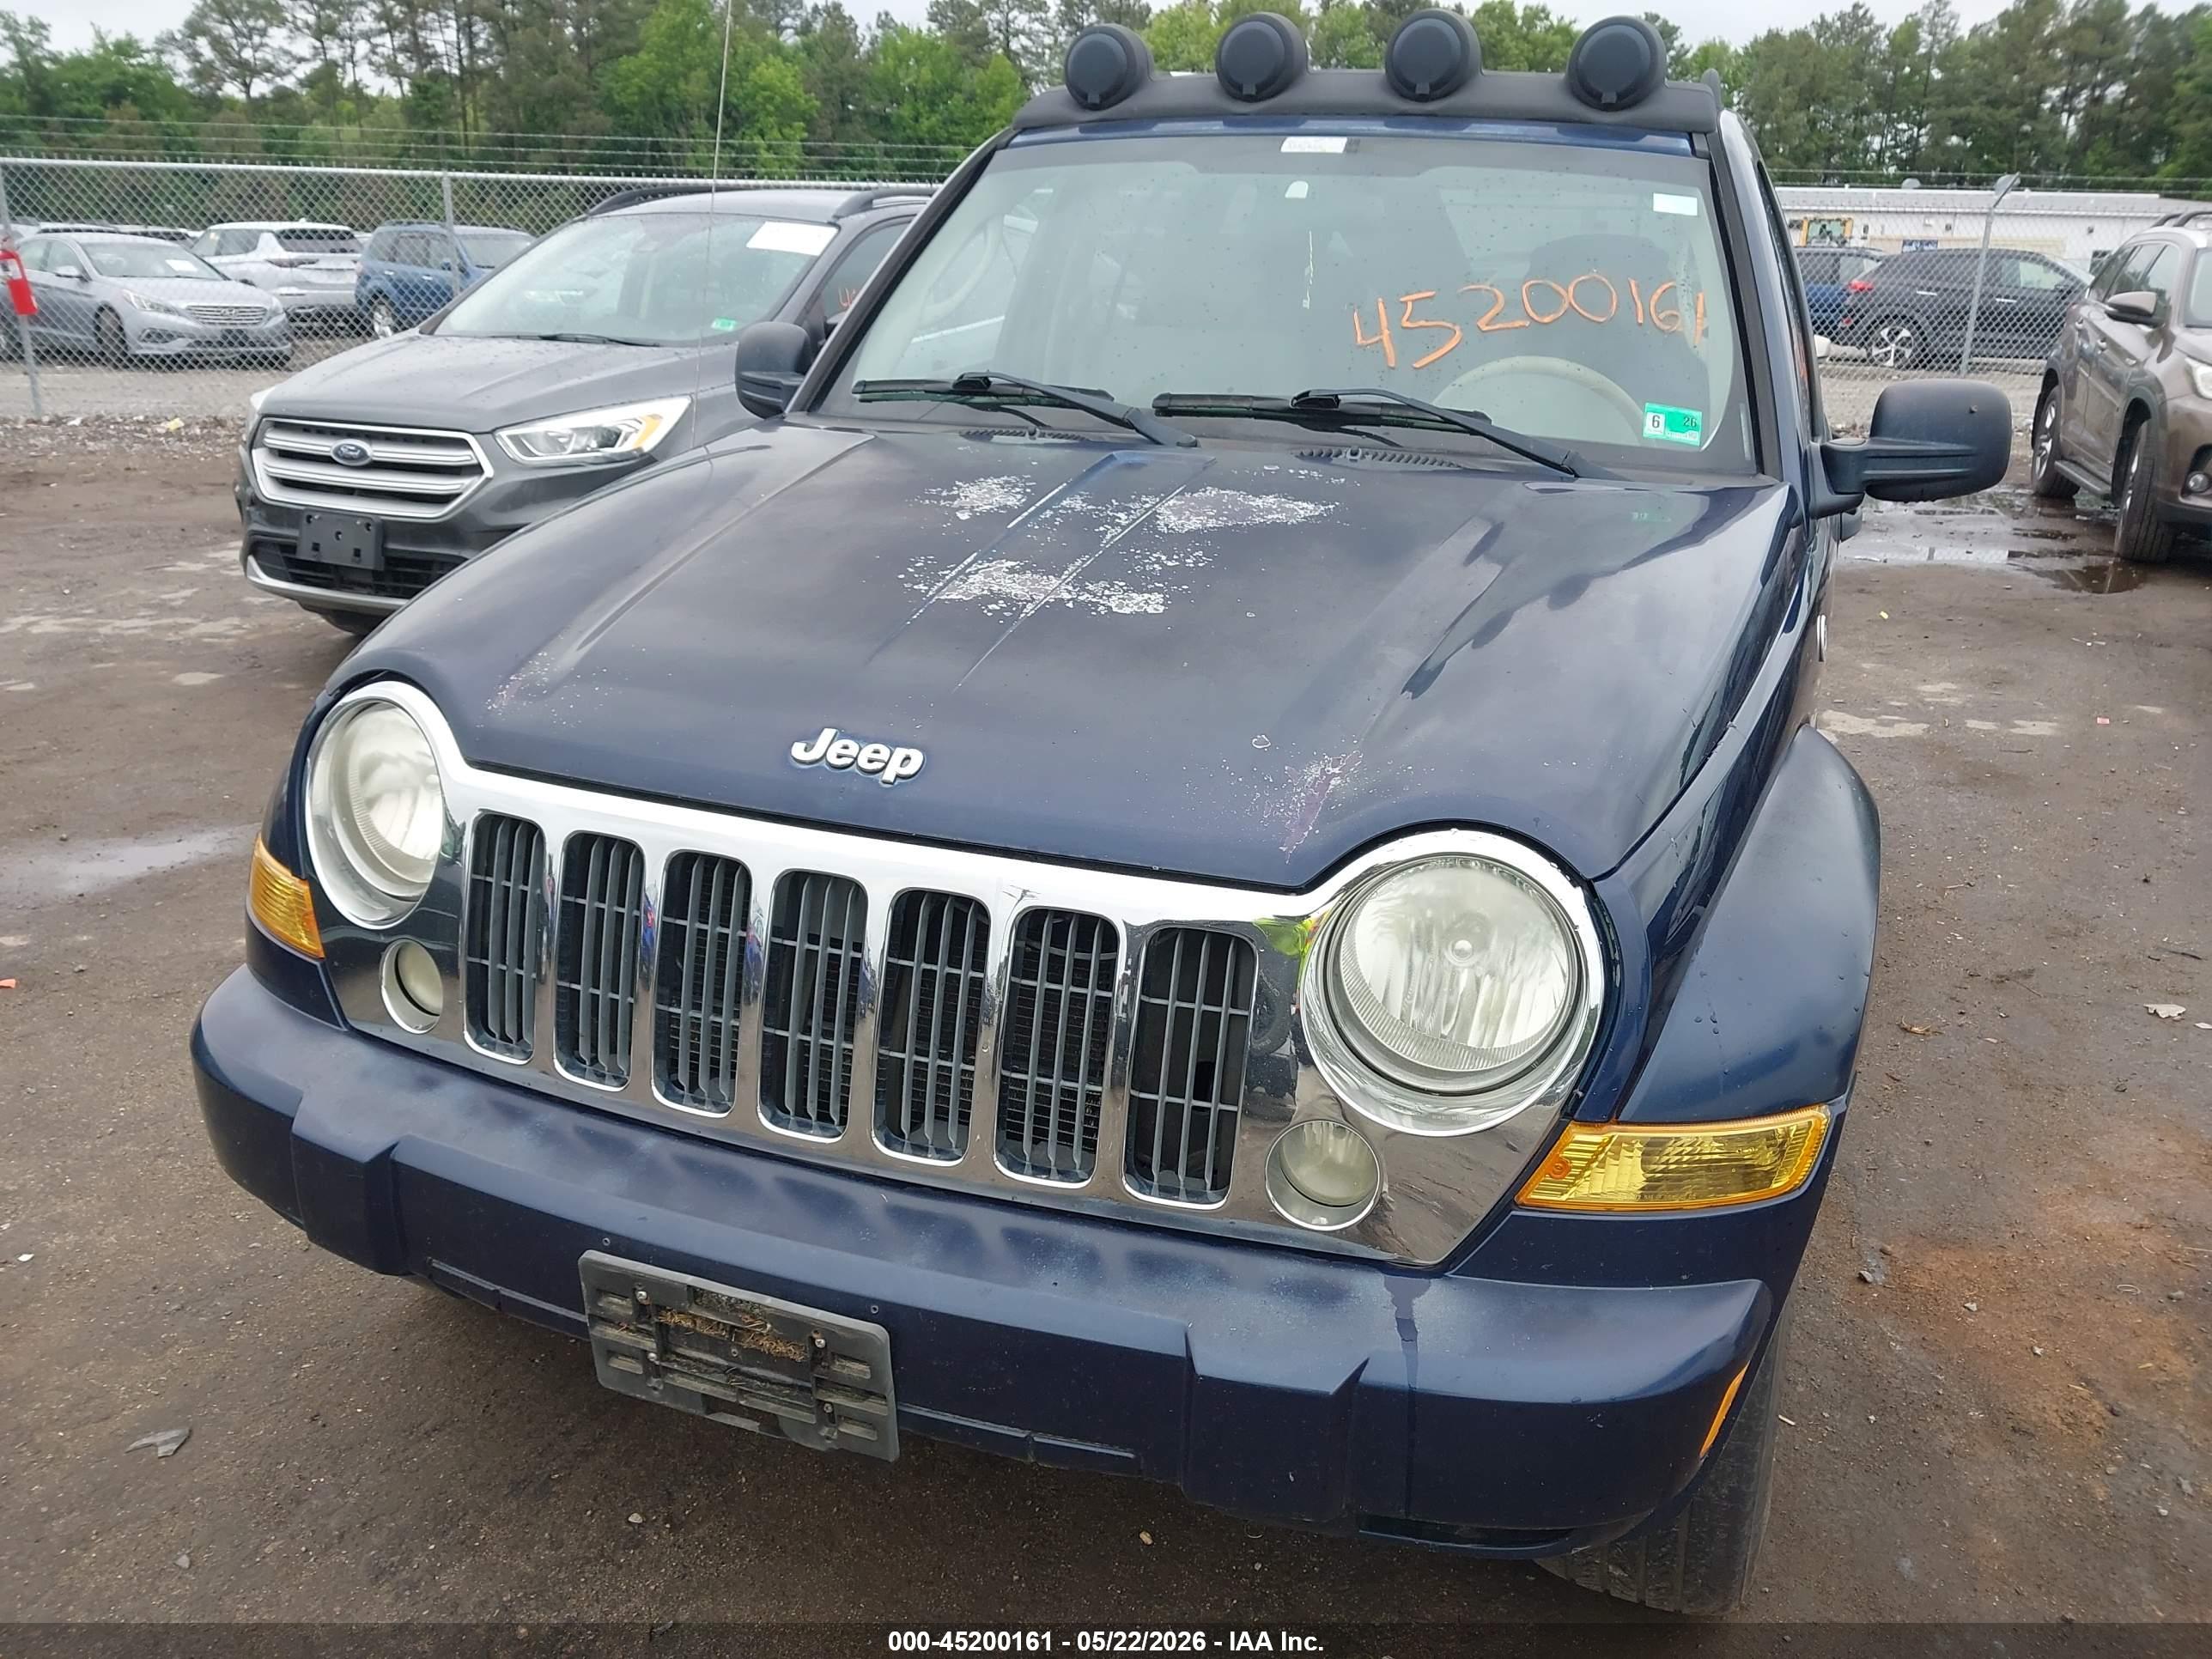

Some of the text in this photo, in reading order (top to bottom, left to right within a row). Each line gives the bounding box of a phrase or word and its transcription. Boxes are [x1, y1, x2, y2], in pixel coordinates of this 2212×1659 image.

[1353, 273, 1705, 369] 45200161
[1651, 414, 1698, 428] 6 26
[790, 727, 925, 785] Jeep
